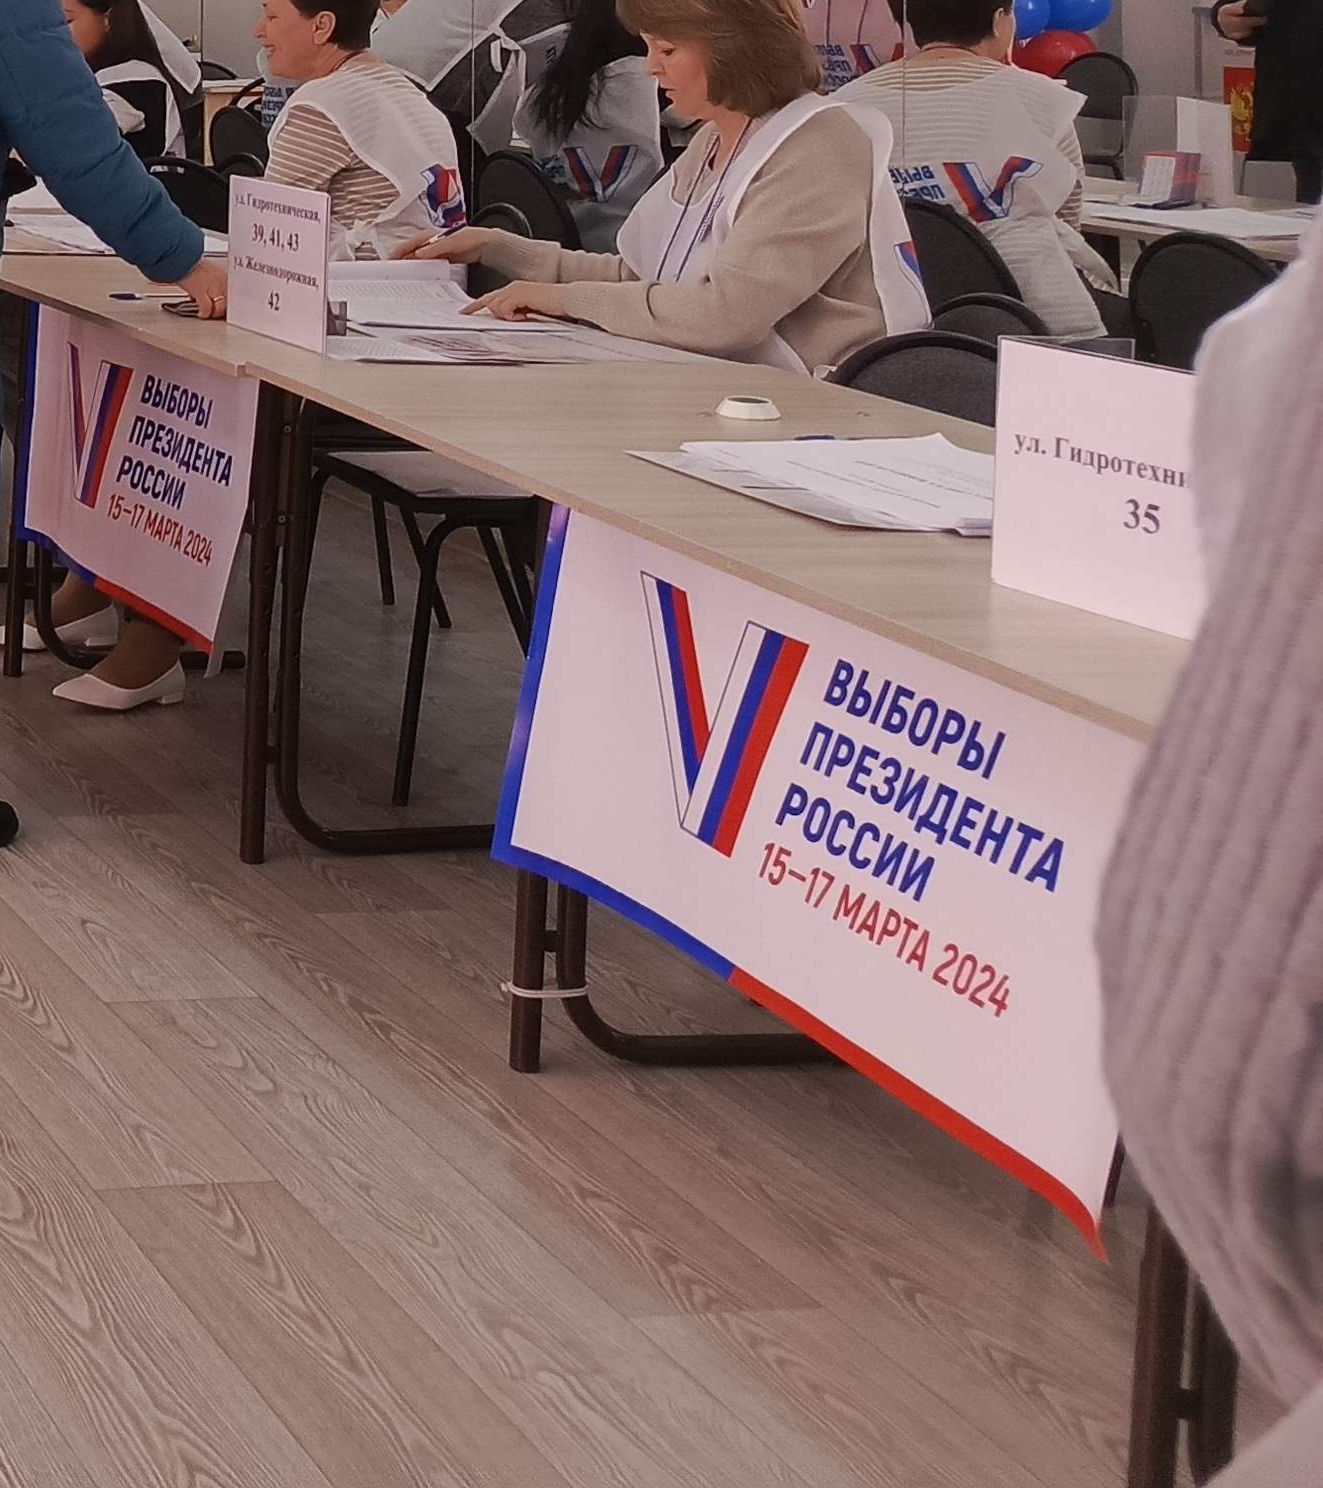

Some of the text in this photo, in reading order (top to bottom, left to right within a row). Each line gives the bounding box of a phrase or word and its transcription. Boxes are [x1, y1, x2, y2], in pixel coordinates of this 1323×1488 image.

[247, 192, 321, 224] Гидротехническая,
[286, 232, 300, 252] 43
[268, 291, 280, 311] 42
[140, 374, 214, 429] ВЫБОРЫ
[128, 414, 234, 487] ПРЕЗИДЕНТА
[1013, 433, 1047, 455] ул.
[116, 454, 186, 511] РОССИИ
[143, 508, 184, 552] МАРТА
[183, 530, 214, 567] 2024
[1123, 498, 1161, 534] 35
[823, 659, 1006, 780] ВЫБОРЫ
[799, 721, 1065, 894] ПРЕЗИДЕНТА
[775, 782, 935, 902] РОССИИ
[832, 884, 930, 972] МАРТА
[932, 943, 1011, 1018] 2024
